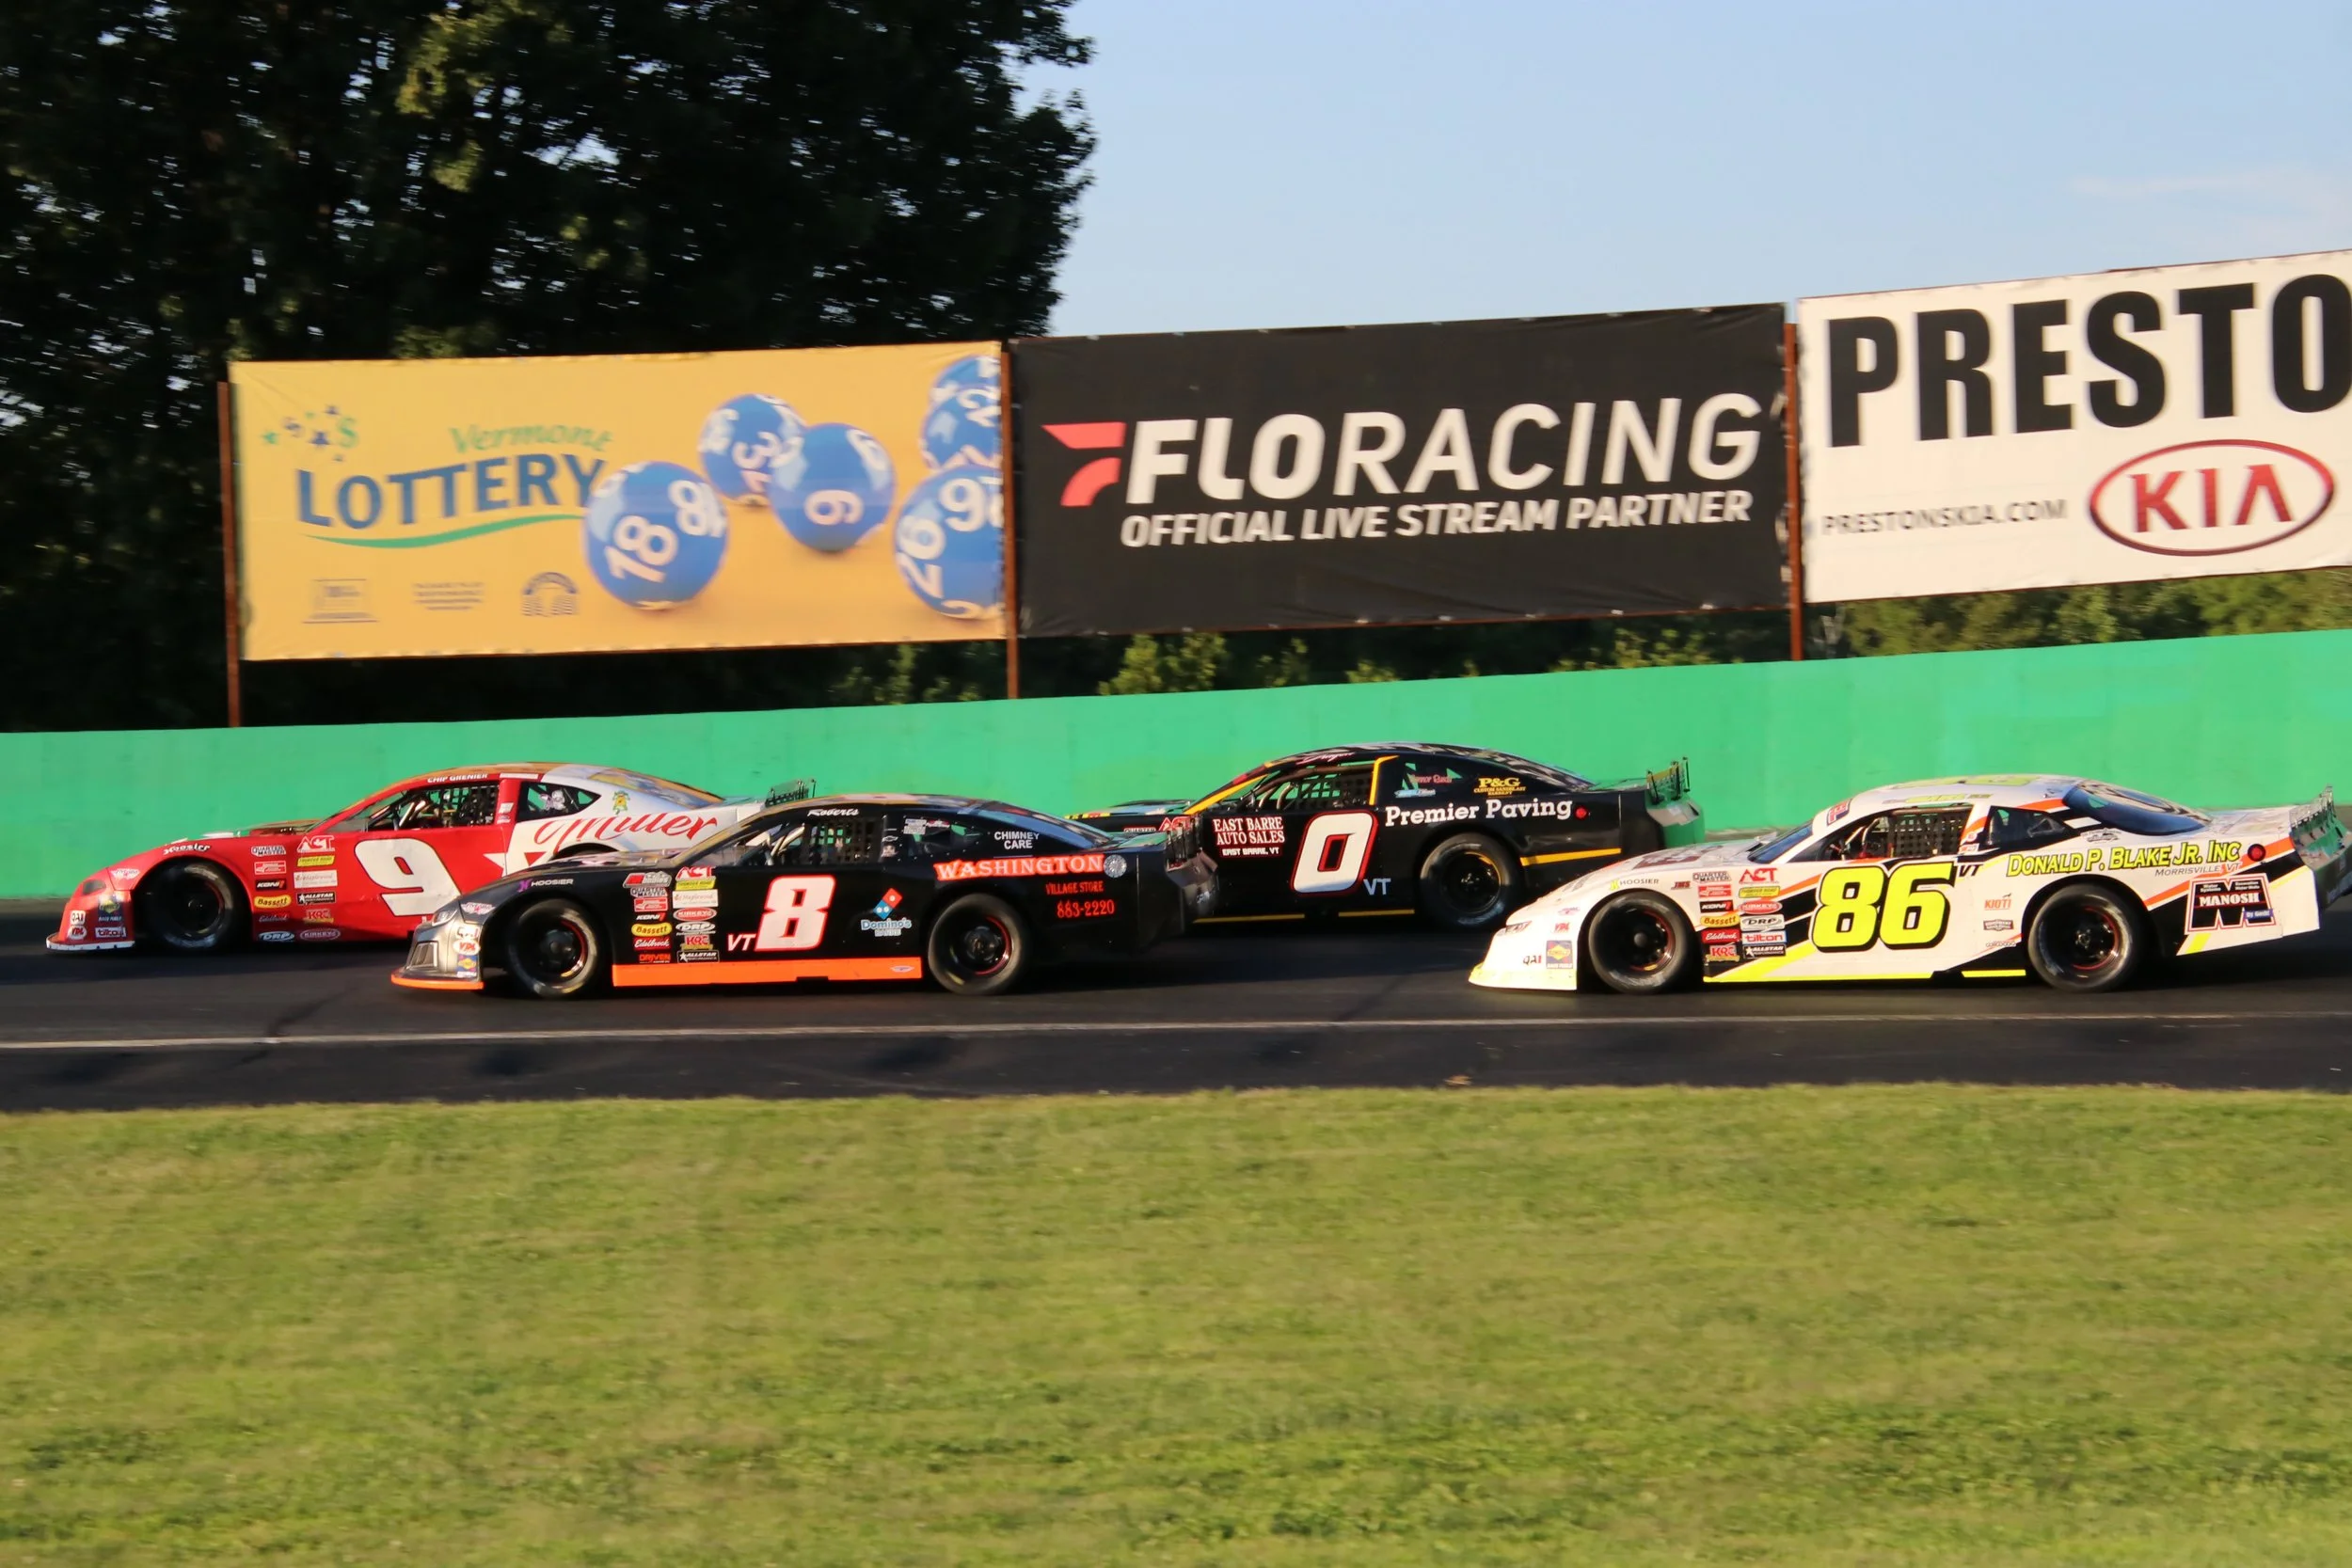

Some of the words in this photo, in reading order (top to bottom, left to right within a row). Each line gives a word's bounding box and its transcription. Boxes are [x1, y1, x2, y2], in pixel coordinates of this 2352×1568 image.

[449, 423, 612, 453] Vermont
[296, 452, 607, 530] LOTTERY
[2129, 464, 2293, 532] KIA
[1120, 511, 1295, 547] OFFICIAL
[1302, 506, 1388, 540] LIVE
[1395, 498, 1558, 537] STREAM
[1565, 491, 1754, 530] PARTNER
[1821, 498, 2068, 535] PRESTONSKIA.COM
[427, 775, 448, 784] CHIP
[450, 773, 488, 782] GRENIER
[1478, 777, 1520, 788] P&G
[807, 808, 860, 816] Roberts
[1385, 803, 1479, 827] Premier
[1486, 799, 1572, 820] Paving
[1213, 818, 1244, 832] EAST
[1247, 816, 1284, 831] BARRE
[297, 835, 336, 852] ACT
[993, 832, 1040, 841] CHIMNEY
[1216, 832, 1248, 846] AUTO
[1248, 830, 1285, 844] SALES
[1004, 839, 1033, 849] CARE
[1293, 811, 1376, 895] 0
[2006, 852, 2083, 877] DONALD
[2085, 848, 2106, 871] P.
[2108, 846, 2171, 870] BLAKE
[2172, 844, 2201, 864] JR.
[2206, 840, 2242, 862] INC
[937, 855, 1104, 879] WASHINGTON
[1959, 863, 1984, 877] VT
[2154, 865, 2221, 877] MORRISVILLE
[2226, 863, 2241, 871] VT
[354, 837, 461, 916] 9
[1693, 871, 1728, 879] QUARTER
[1739, 867, 1777, 882] ACT
[531, 879, 574, 887] HOOSIER
[1045, 882, 1078, 895] VILLAGE
[1079, 881, 1104, 893] STORE
[1364, 879, 1391, 895] VT
[257, 897, 288, 906] Bassett
[1812, 863, 1956, 951] 86
[1984, 899, 2011, 909] KIOTI
[2199, 893, 2260, 907] MANOSH
[755, 875, 836, 951] 8
[1056, 899, 1116, 918] 883-2220
[861, 917, 912, 930] Domino's
[1704, 916, 1737, 925] Bassett
[636, 926, 668, 934] Bassett
[1705, 931, 1738, 940] Edelbrock
[634, 937, 670, 948] Edelbrock
[727, 934, 755, 952] VT
[1711, 946, 1736, 957] KRC
